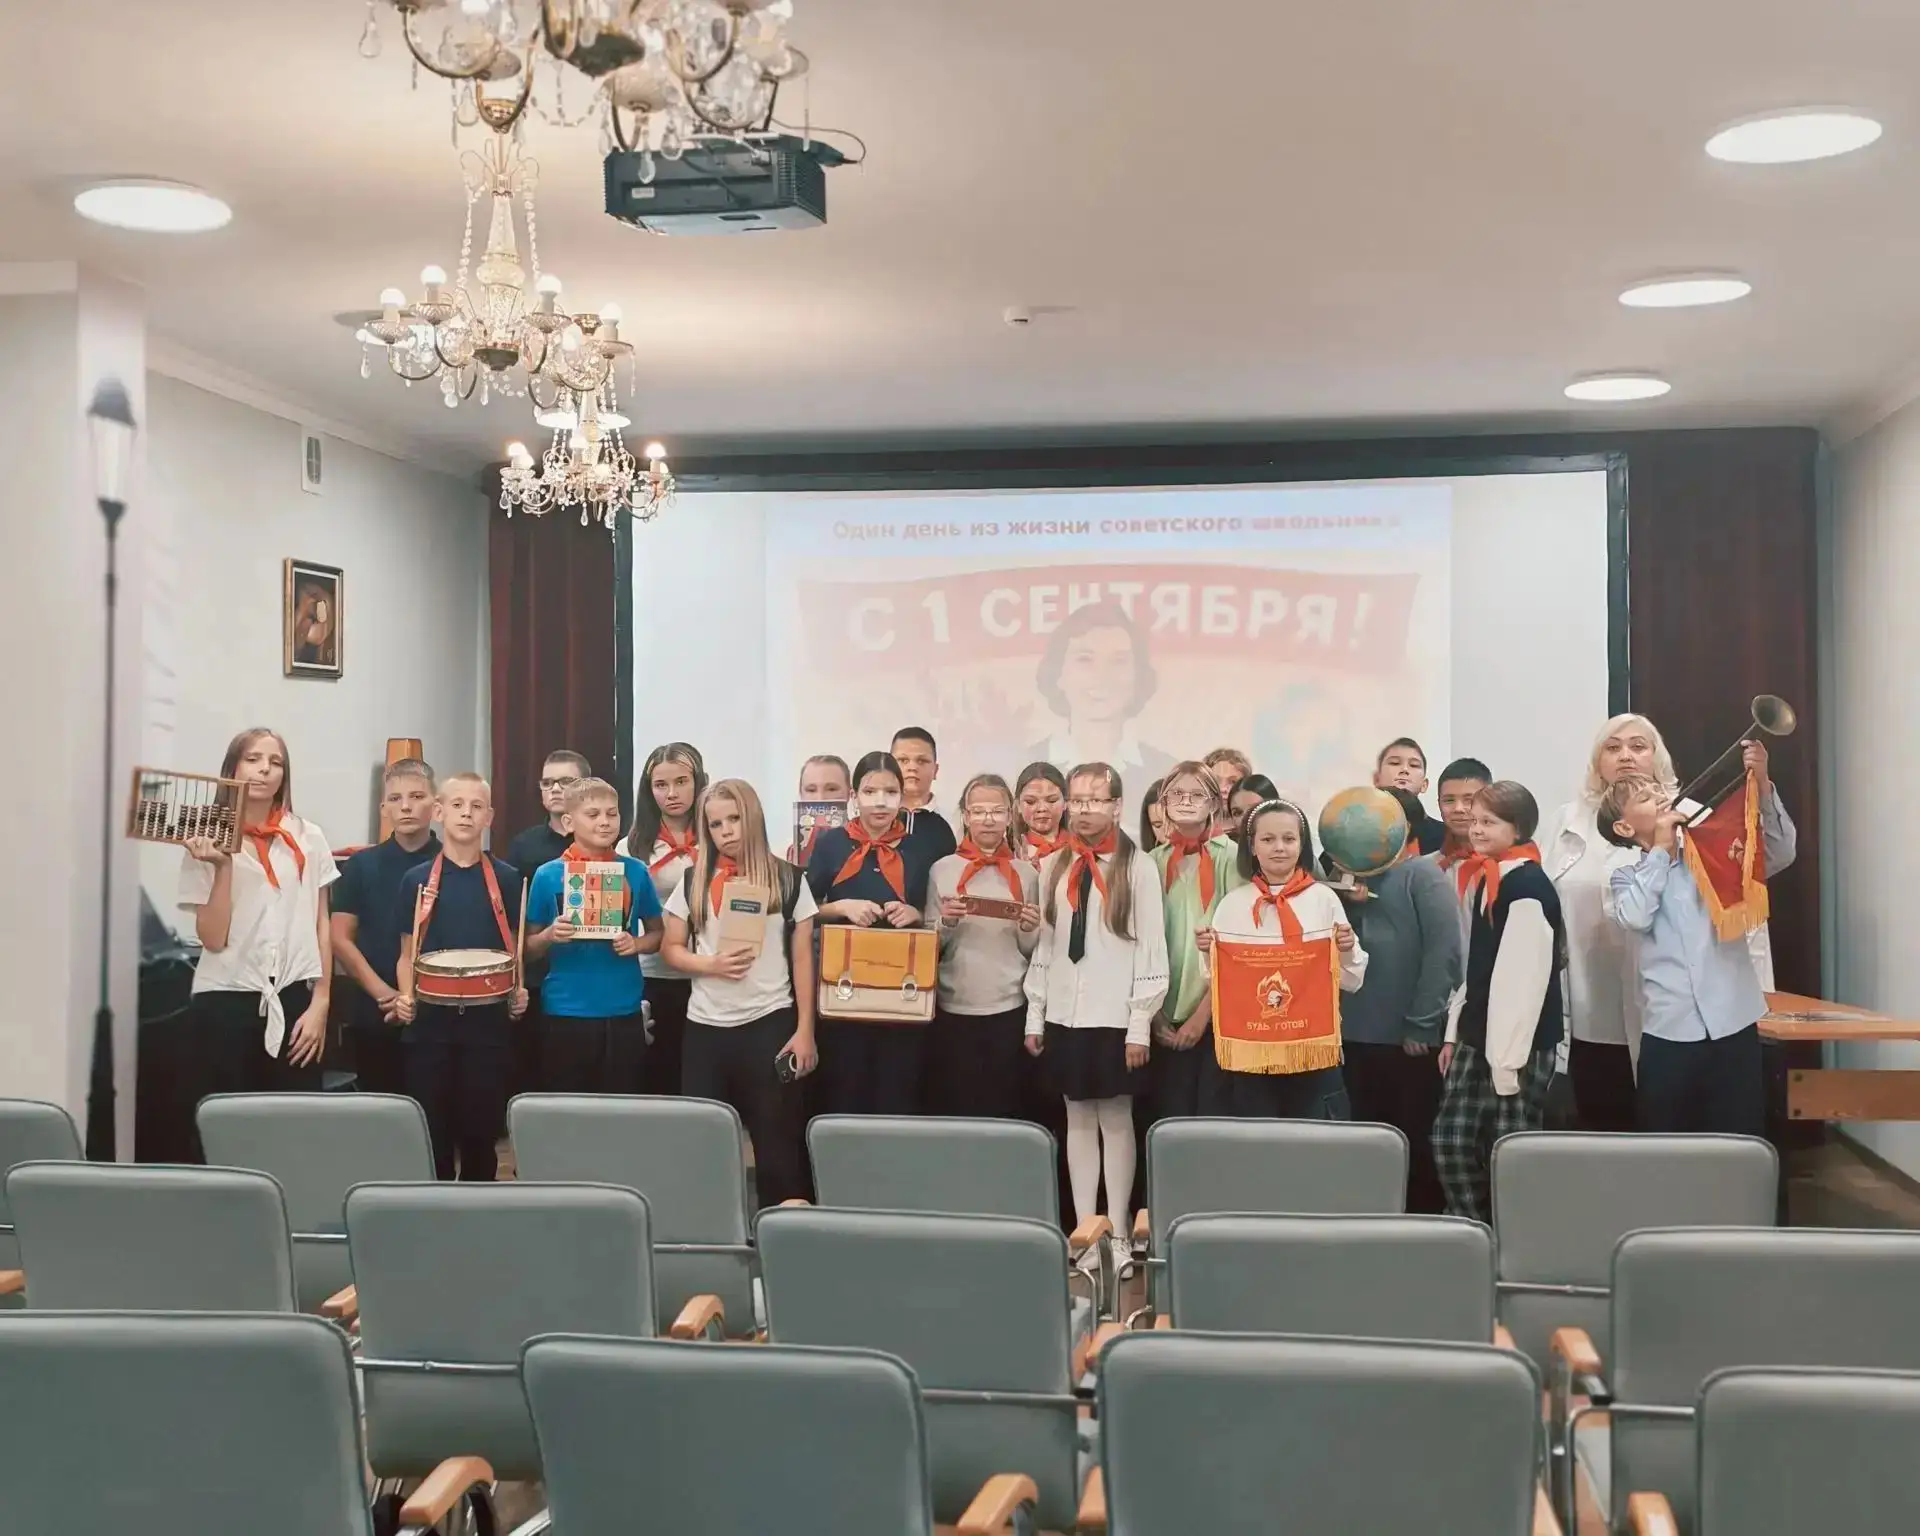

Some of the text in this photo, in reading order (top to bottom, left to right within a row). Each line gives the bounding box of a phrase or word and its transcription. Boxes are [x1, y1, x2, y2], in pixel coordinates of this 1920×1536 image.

[832, 521, 895, 540] Один
[903, 520, 962, 540] день
[969, 521, 1000, 537] из
[1007, 519, 1091, 535] жизни
[1099, 516, 1243, 534] советского
[847, 581, 1374, 652] С 1 СЕНТЯБРЯ!
[1246, 1022, 1270, 1031] БУДЬ
